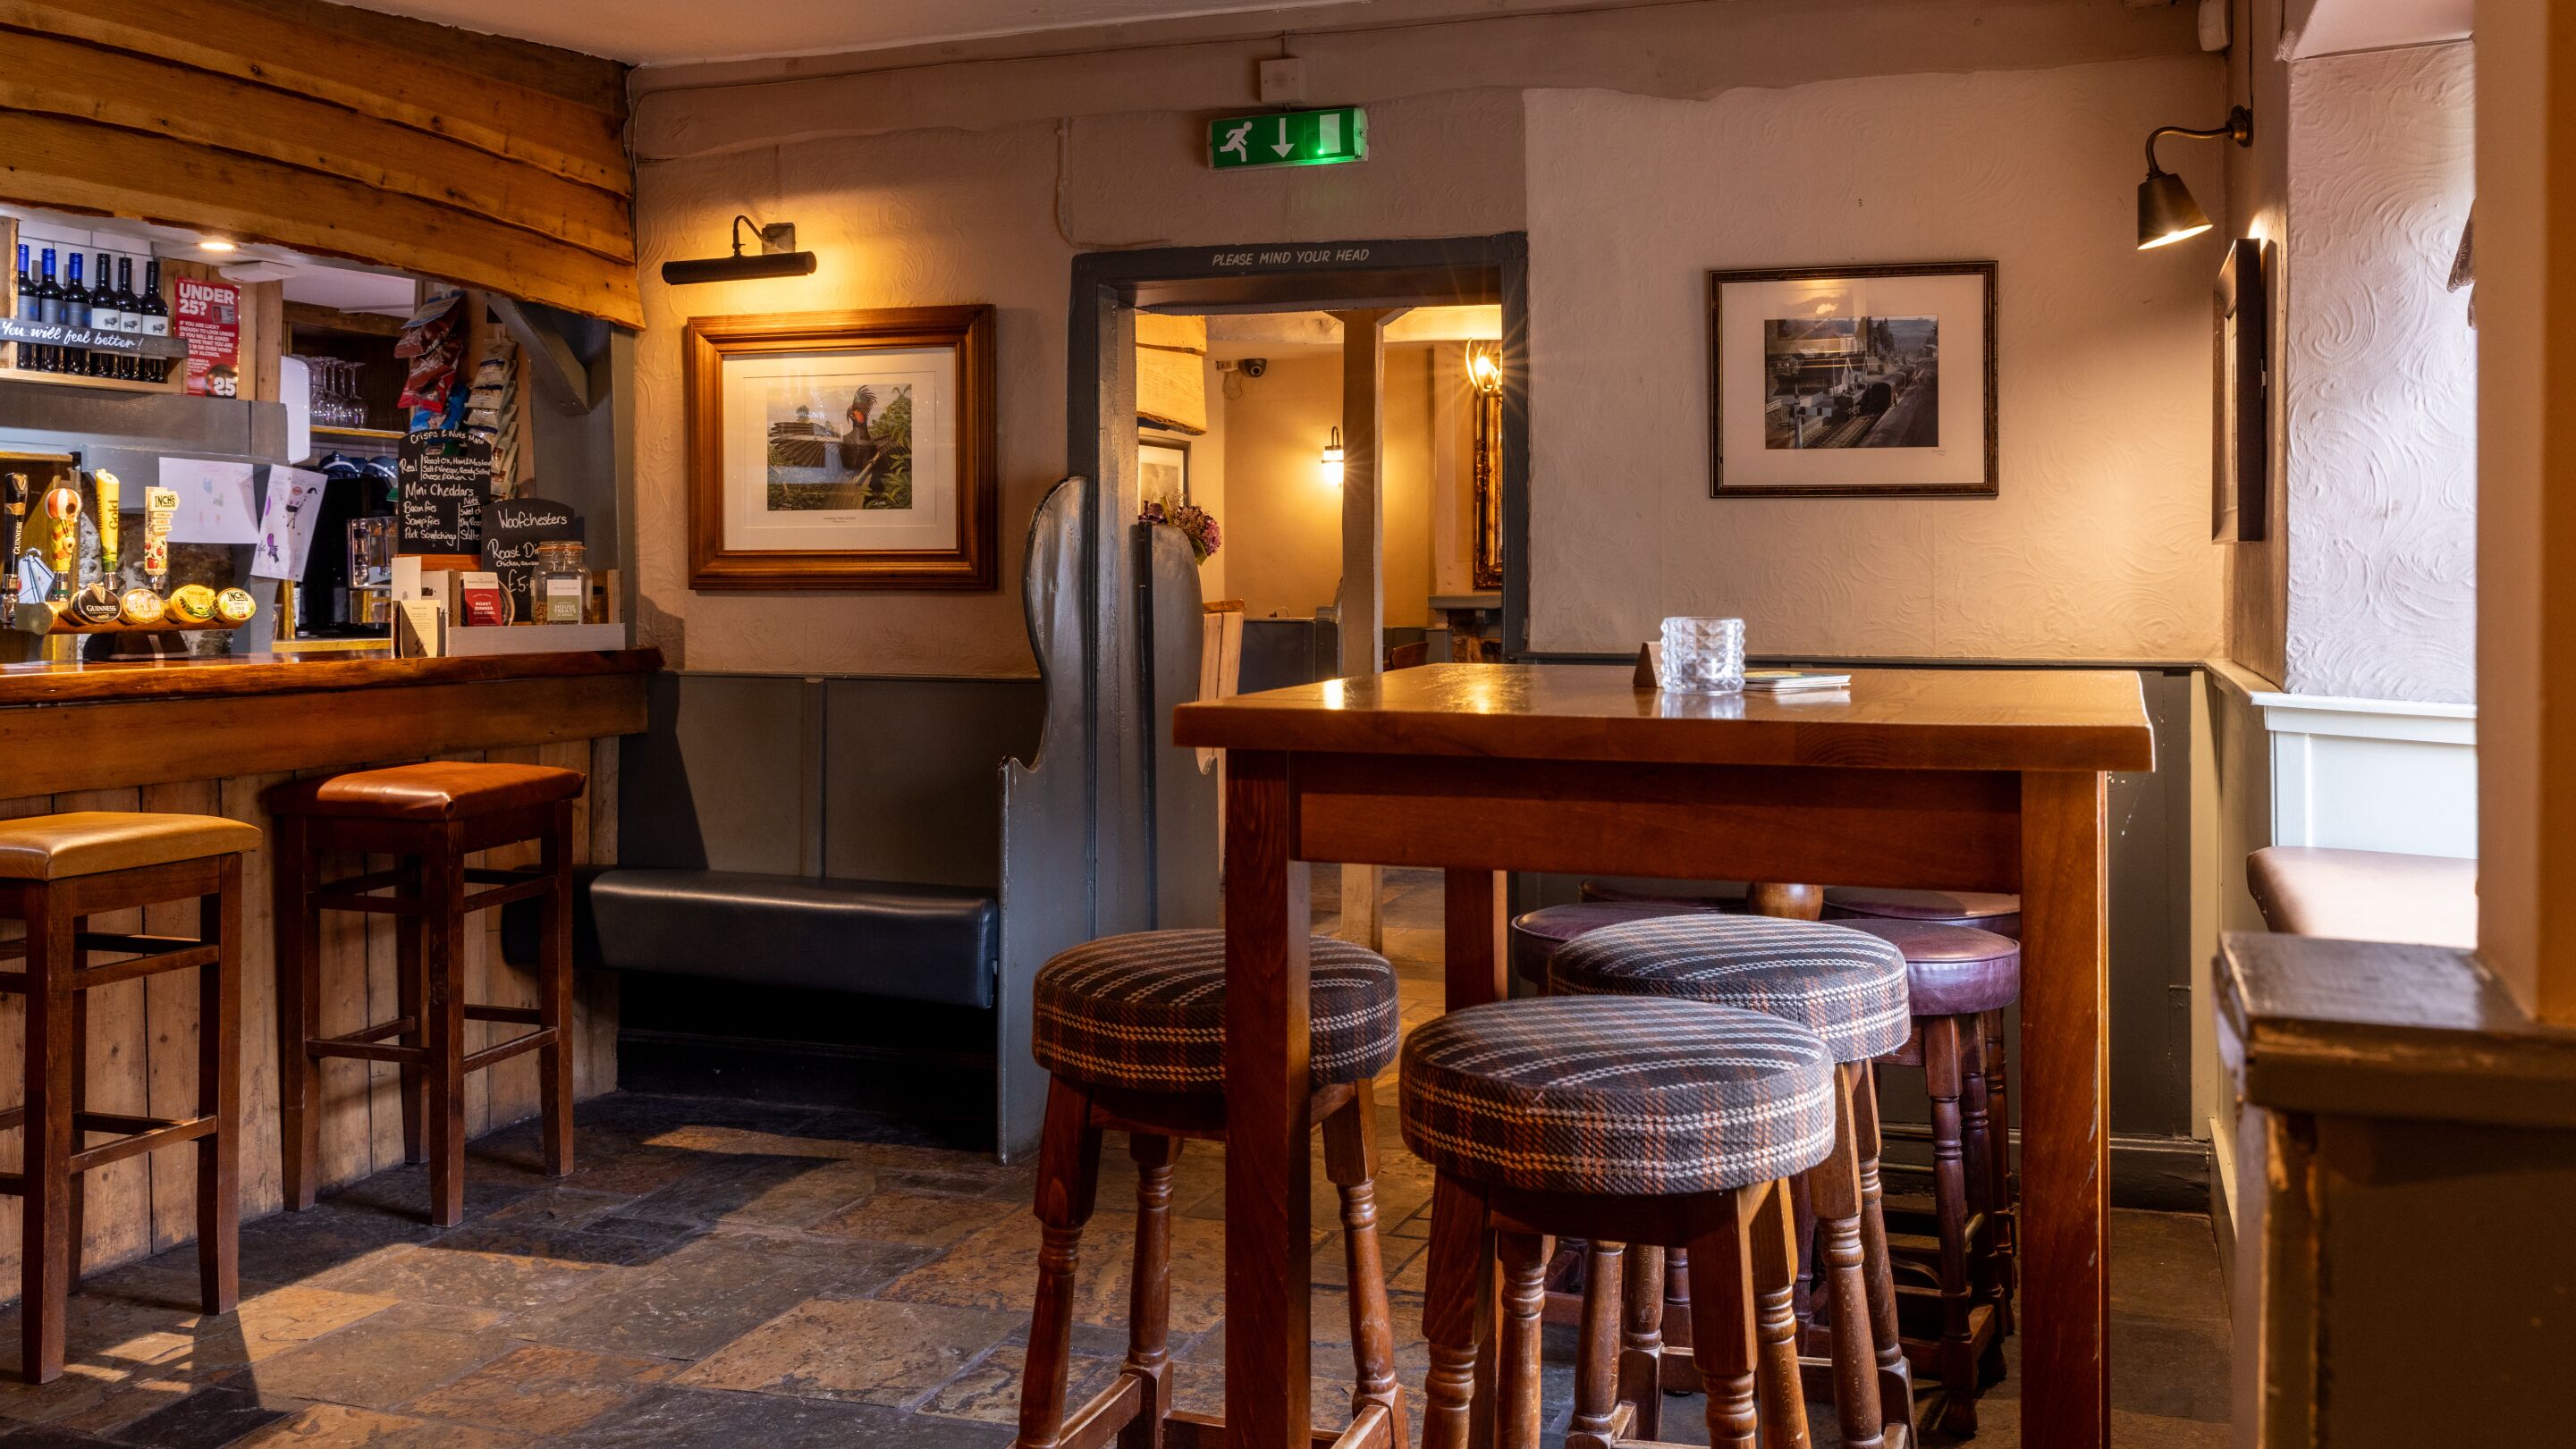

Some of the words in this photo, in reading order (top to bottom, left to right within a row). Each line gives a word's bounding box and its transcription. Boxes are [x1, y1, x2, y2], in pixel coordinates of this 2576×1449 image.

[1212, 253, 1254, 266] PLEASE
[1259, 251, 1291, 265] MIND
[1296, 250, 1330, 263] YOUR
[1336, 249, 1370, 261] HEAD
[179, 282, 234, 305] UNDER
[179, 299, 207, 316] 25?
[2, 321, 24, 336] You
[31, 325, 61, 339] will
[63, 328, 90, 345] feel
[214, 376, 236, 396] 25
[410, 431, 438, 444] Crisps
[449, 430, 466, 439] Nuts
[399, 458, 418, 474] Real
[423, 456, 440, 465] Roast
[405, 481, 427, 501] Mini
[430, 483, 474, 497] Cheddars
[108, 500, 119, 530] Gold
[403, 501, 424, 514] Bacon
[497, 508, 568, 528] Woofchesters
[13, 521, 23, 555] GUINNESS
[404, 527, 418, 540] Pork
[487, 538, 520, 560] Roast
[87, 604, 117, 612] GUINNESS
